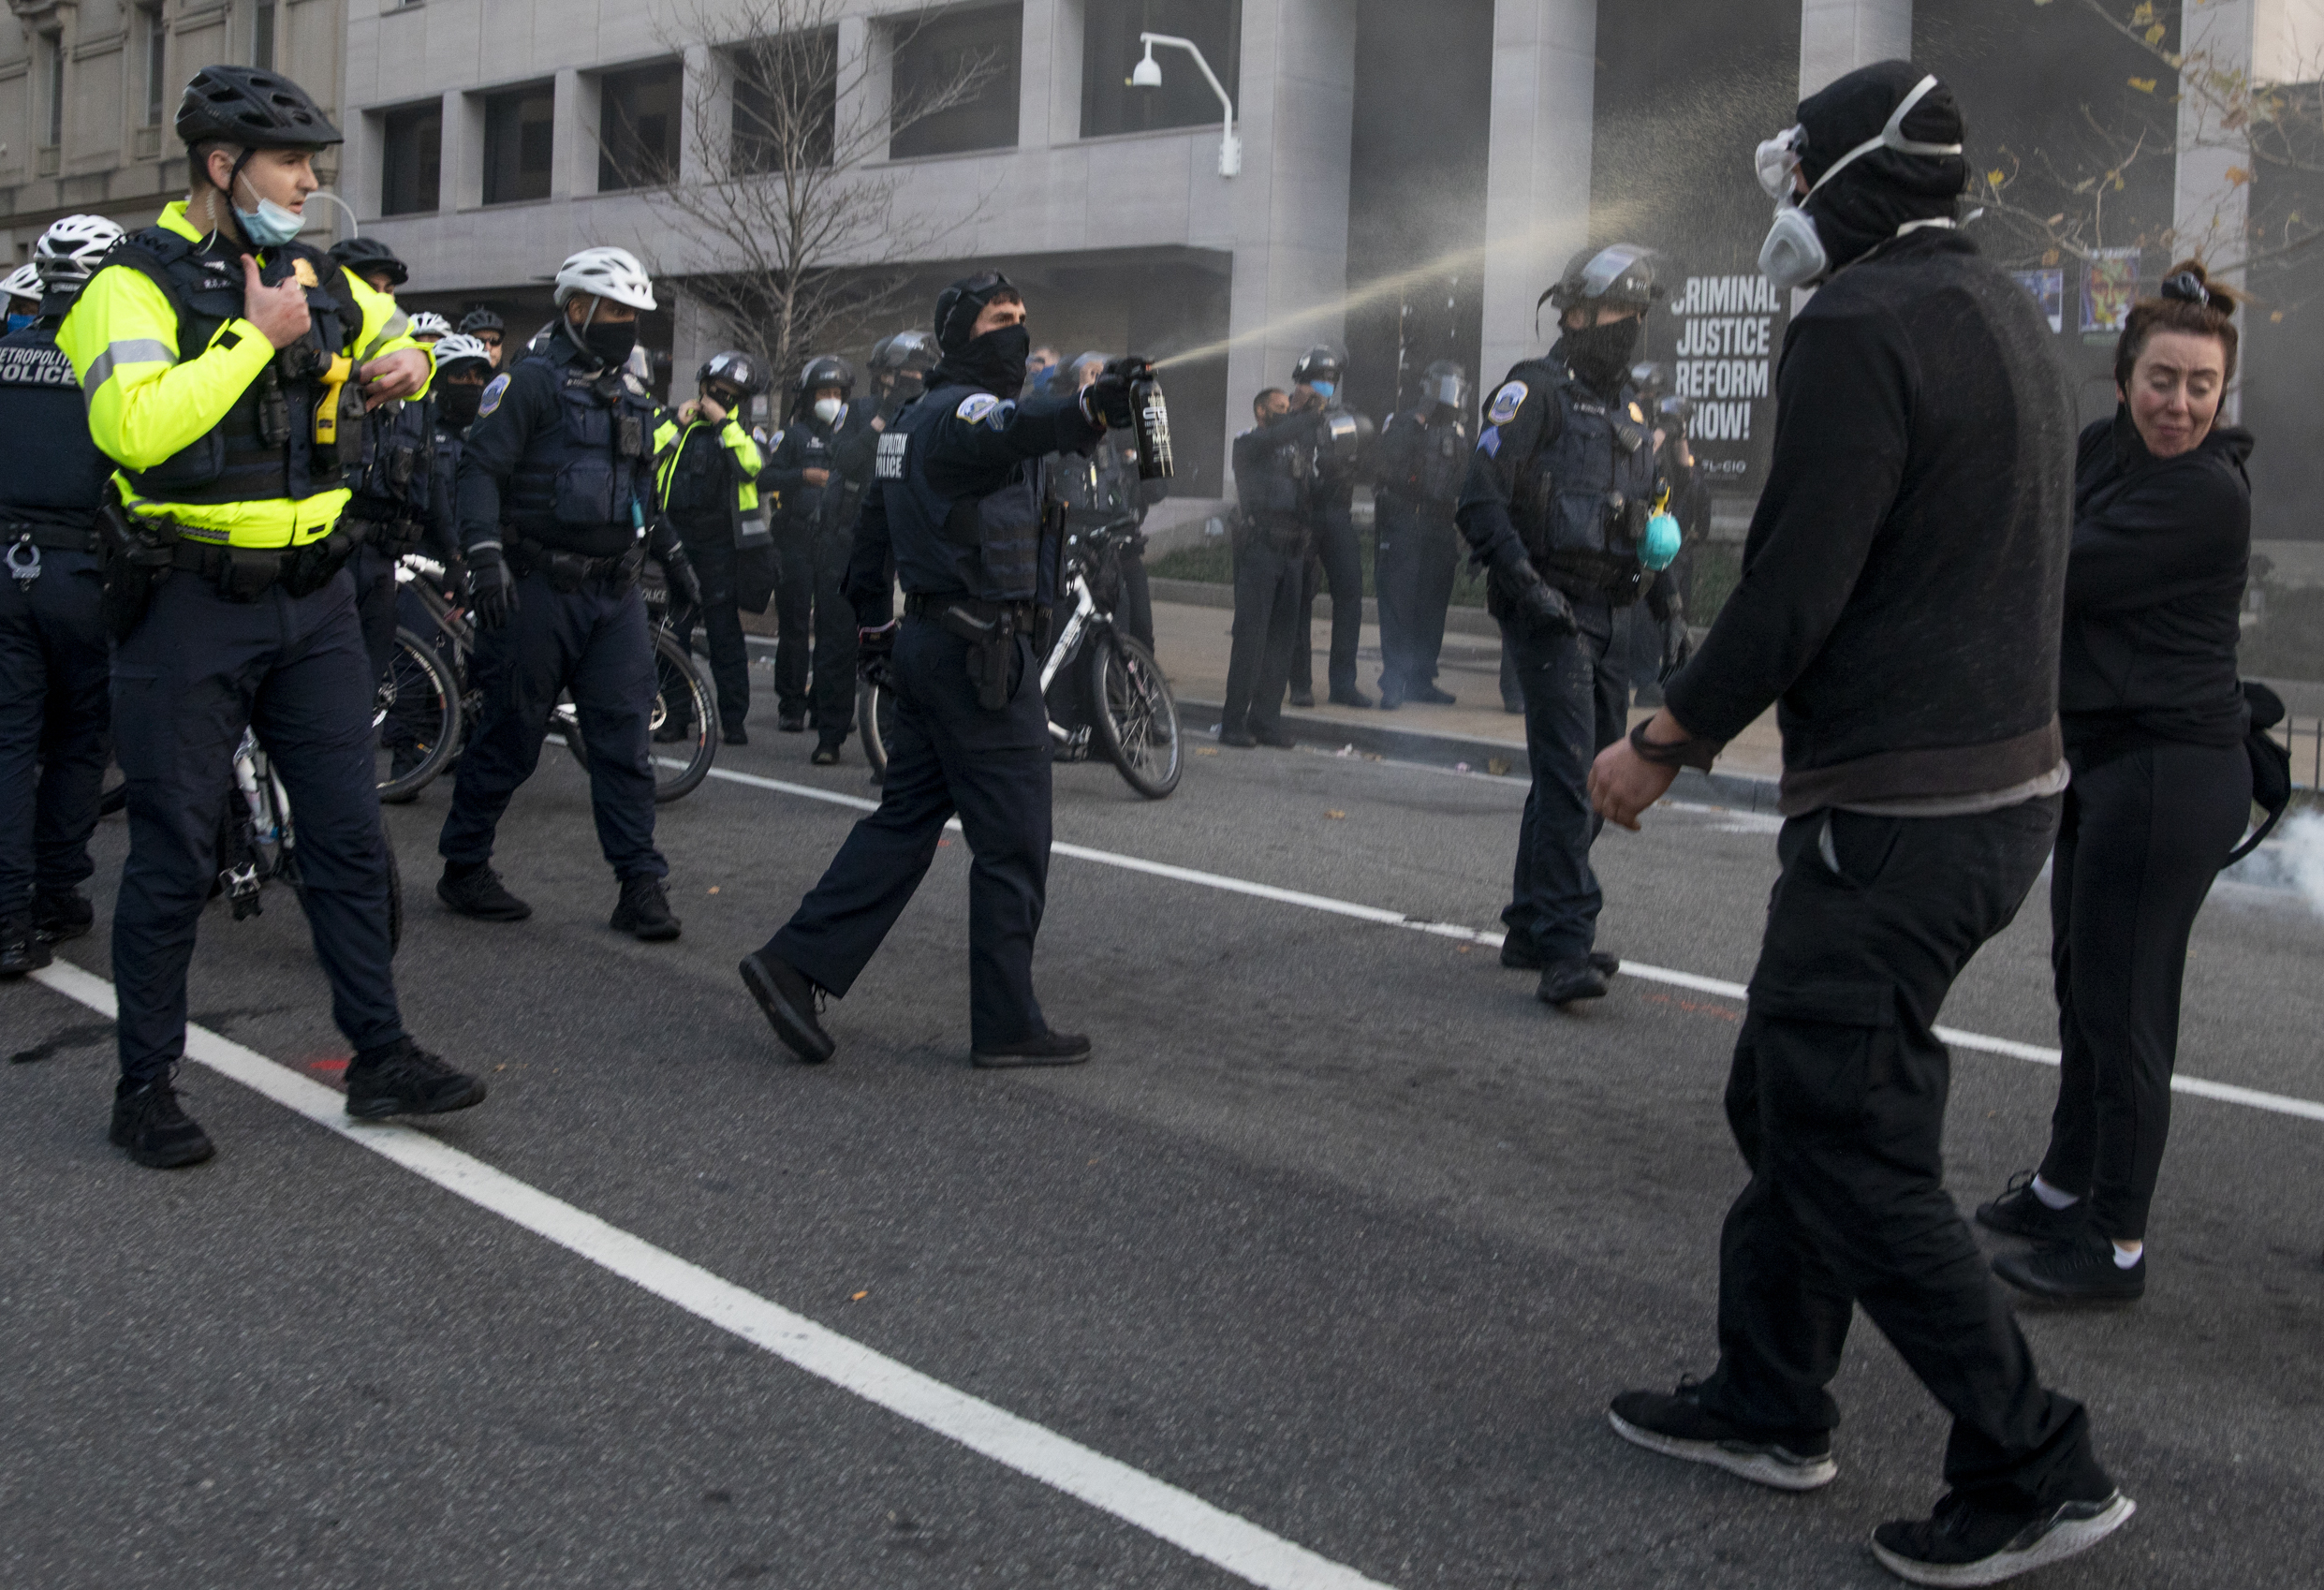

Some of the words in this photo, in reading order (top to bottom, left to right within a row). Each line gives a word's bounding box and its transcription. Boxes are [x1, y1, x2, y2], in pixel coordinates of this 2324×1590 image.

[1676, 317, 1771, 357] JUSTICE
[0, 347, 72, 368] ETROPOLIT
[1675, 359, 1769, 398] REFORM
[1689, 401, 1751, 441] NOW!
[641, 587, 667, 603] OLICE
